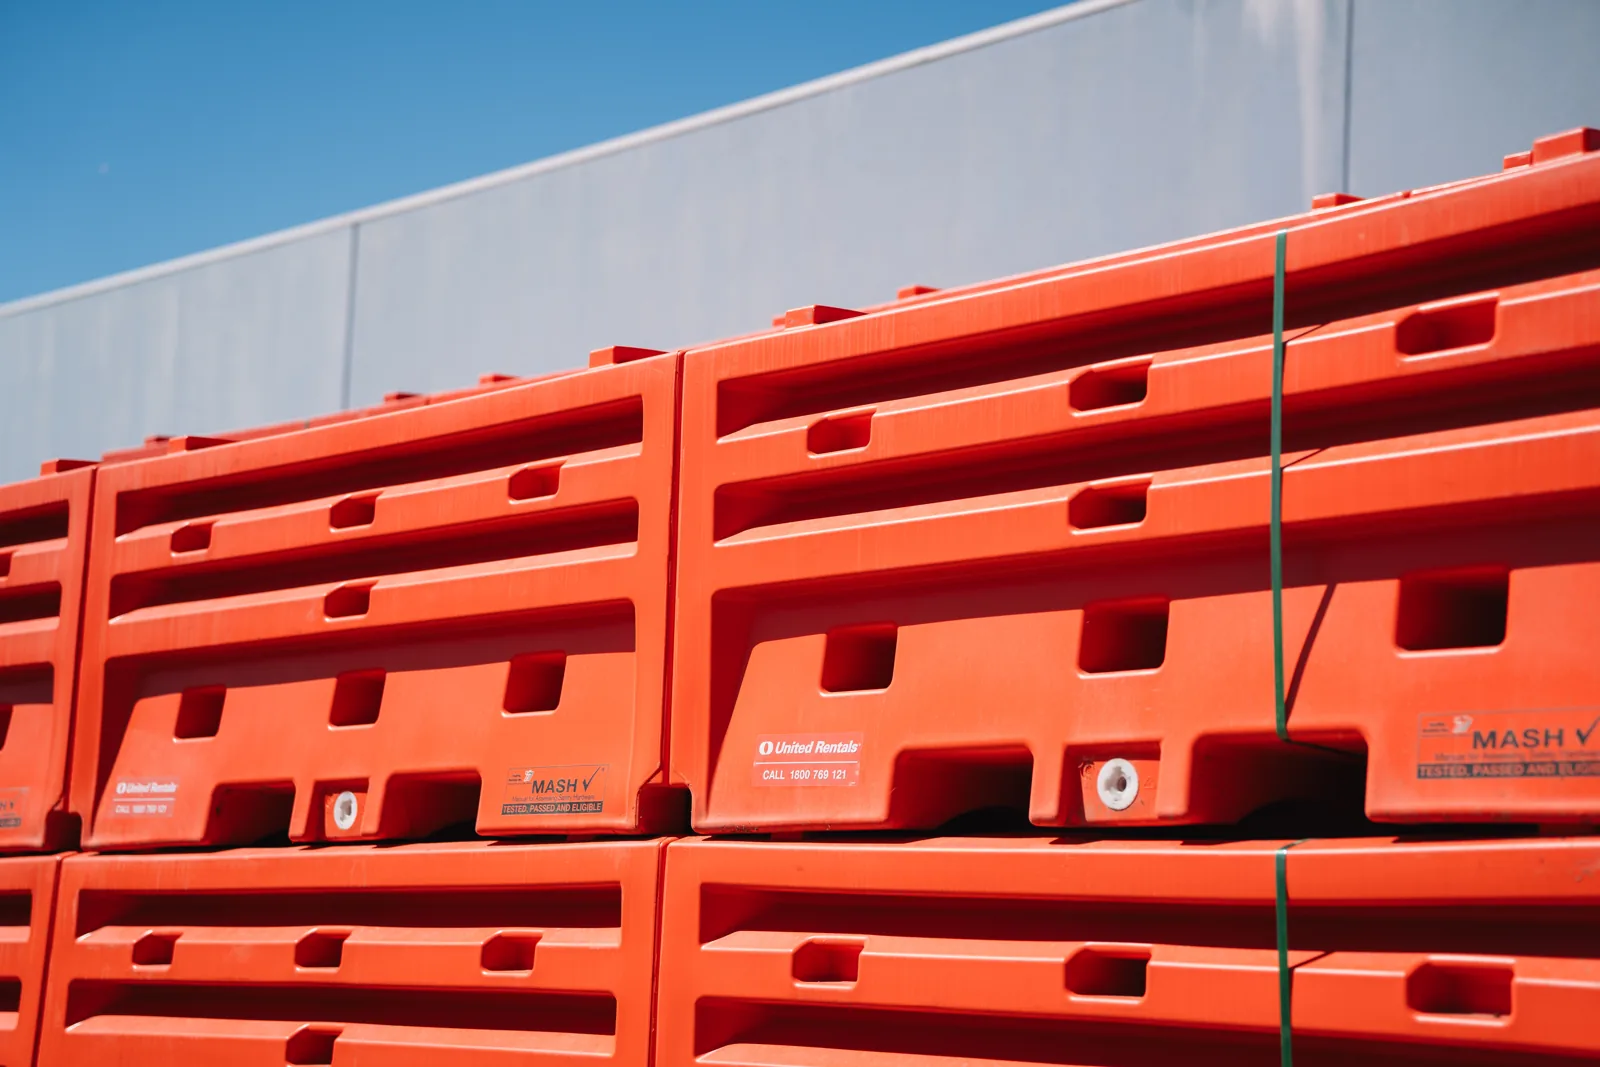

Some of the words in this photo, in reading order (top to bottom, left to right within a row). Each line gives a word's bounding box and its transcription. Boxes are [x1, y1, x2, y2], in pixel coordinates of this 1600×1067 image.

[1473, 728, 1564, 749] MASH
[775, 741, 814, 754] United
[815, 740, 858, 753] Rentals
[763, 770, 785, 780] CALL
[790, 769, 810, 780] 1800
[813, 769, 829, 780] 769
[832, 769, 847, 779] 121
[531, 778, 578, 794] MASH
[529, 804, 555, 813] PASSED
[556, 803, 571, 812] AND
[571, 802, 602, 812] ELIGIBLE
